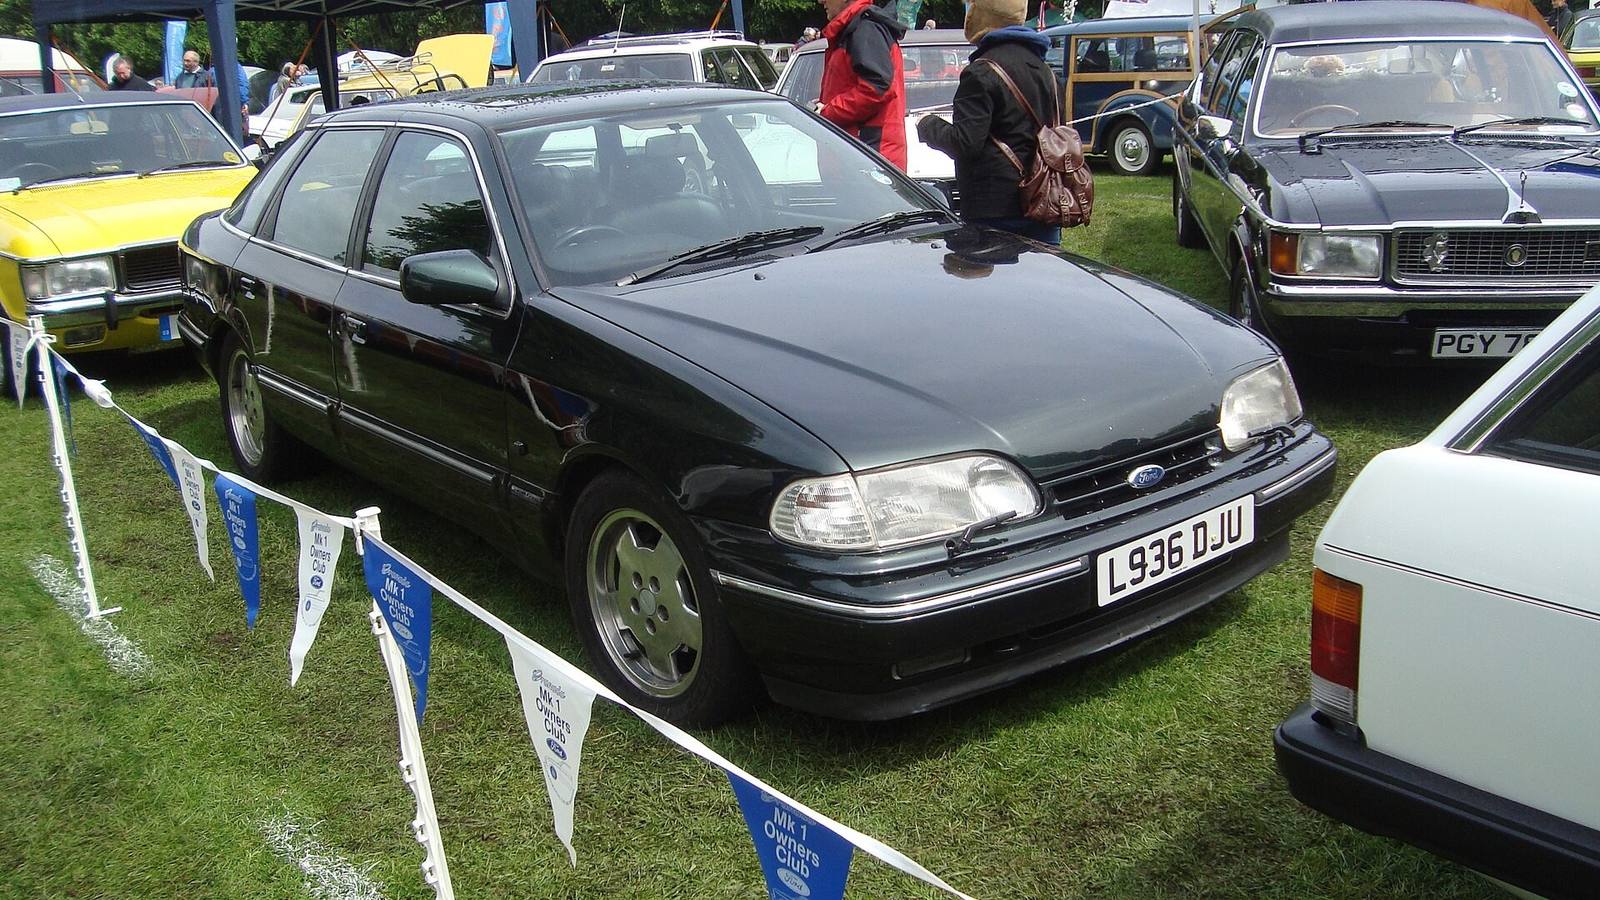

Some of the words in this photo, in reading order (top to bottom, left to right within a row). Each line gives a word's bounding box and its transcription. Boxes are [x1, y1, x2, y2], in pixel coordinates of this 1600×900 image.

[1436, 334, 1496, 354] PGY
[226, 509, 246, 529] Owners
[232, 522, 244, 538] Club
[314, 532, 323, 546] Mk
[324, 535, 328, 547] 1
[1108, 530, 1183, 596] L936
[1192, 505, 1242, 560] DJU
[310, 544, 331, 562] Owners
[312, 559, 326, 574] Club
[385, 577, 398, 596] Mk
[400, 588, 405, 600] 1
[380, 588, 415, 618] Owners
[389, 605, 410, 627] Club
[539, 686, 554, 706] Mk
[556, 699, 561, 712] 1
[536, 697, 571, 734] Owners
[544, 718, 566, 744] Club
[774, 807, 795, 834] Mk
[800, 824, 807, 841] 1
[764, 820, 820, 868] Owners
[776, 844, 810, 879] Club
